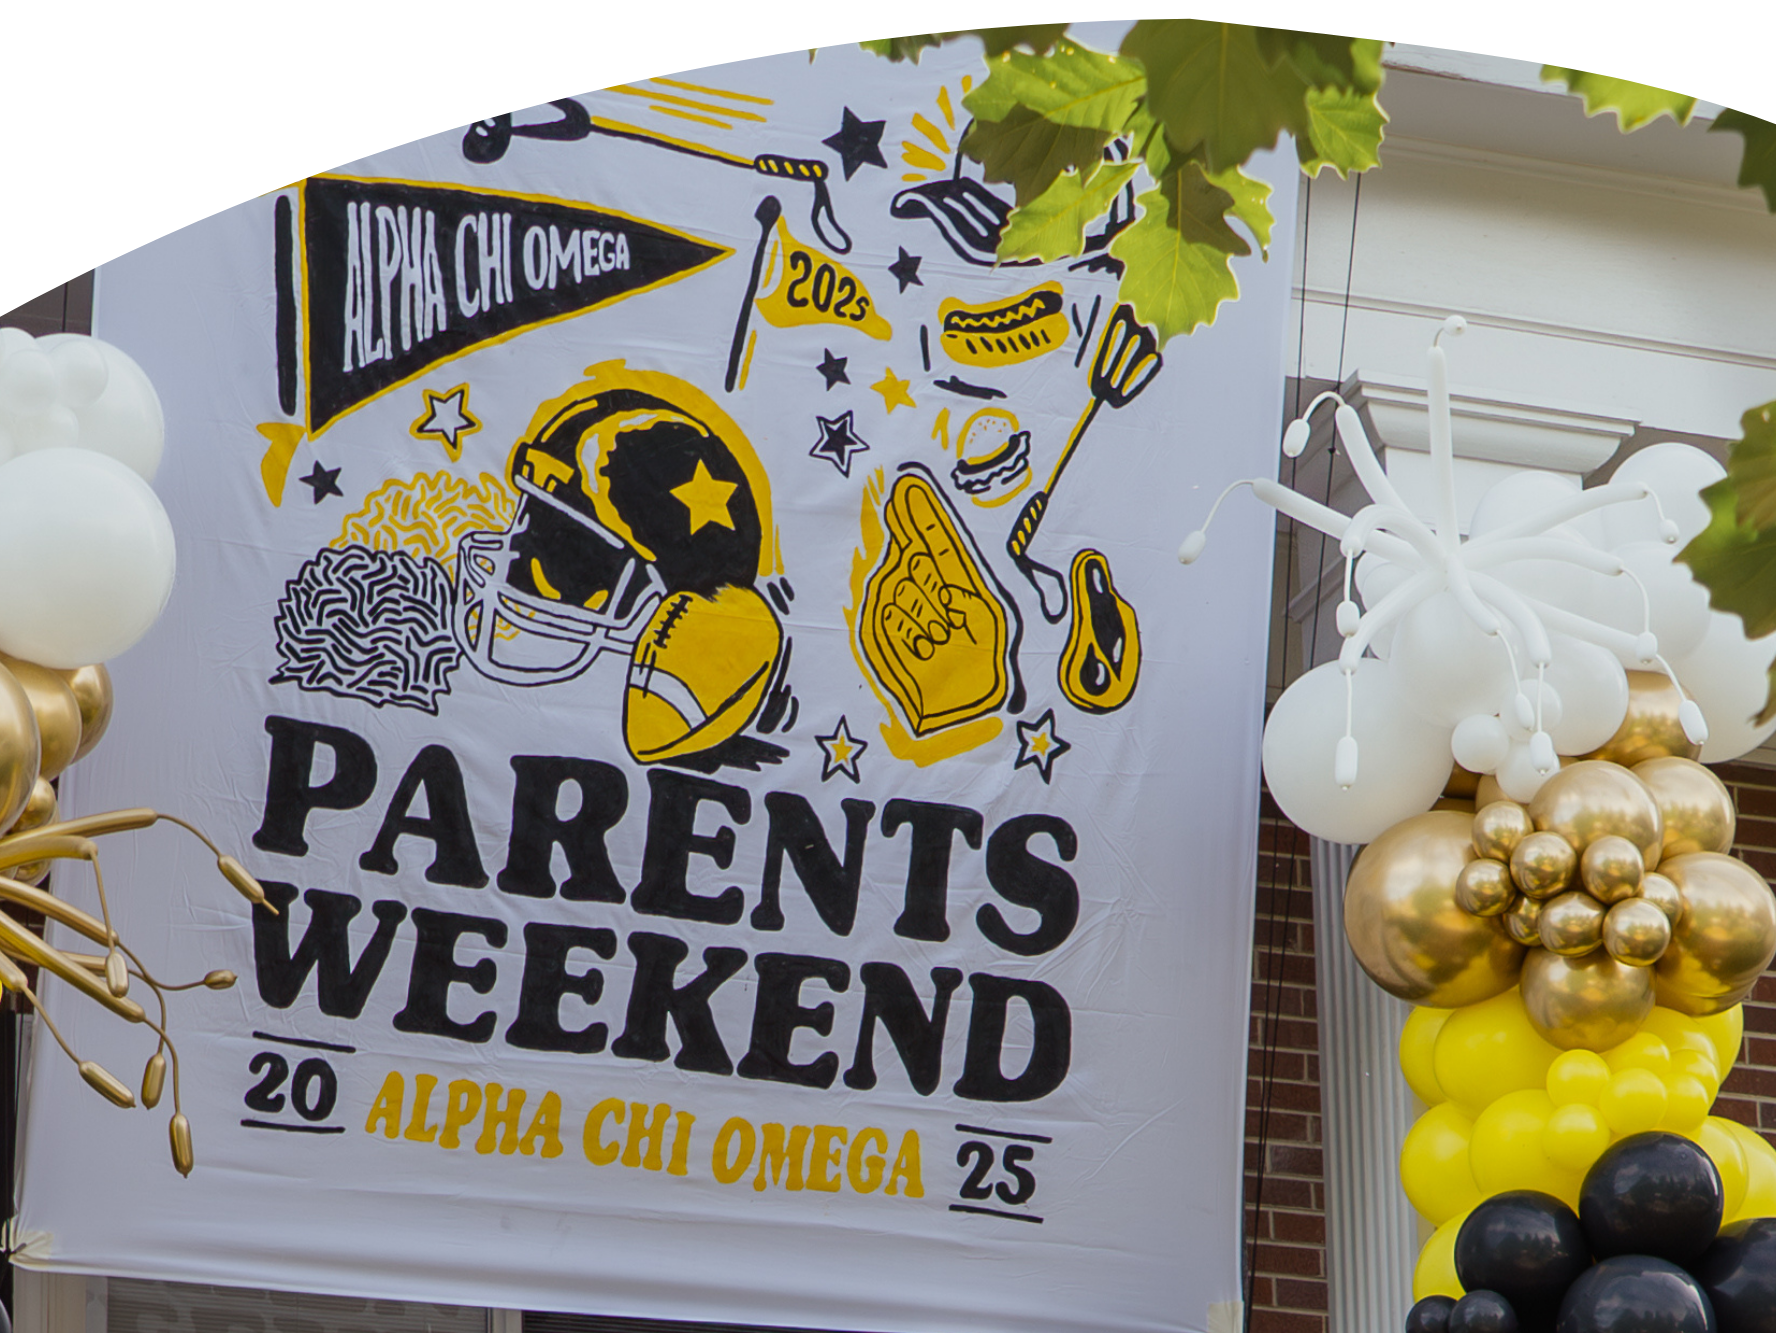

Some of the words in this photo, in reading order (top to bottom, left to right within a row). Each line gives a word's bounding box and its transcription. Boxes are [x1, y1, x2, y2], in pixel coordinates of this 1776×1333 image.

[343, 202, 447, 373] ALPHA
[454, 211, 514, 319] CHI
[523, 225, 631, 291] OMEGA
[786, 250, 871, 322] 2025
[251, 714, 1081, 958] PARENTS
[250, 881, 1073, 1104] WEEKEND
[244, 1051, 339, 1123] 20
[364, 1070, 565, 1160] ALPHA
[582, 1097, 697, 1178] CHI
[711, 1116, 926, 1200] OMEGA
[956, 1140, 1037, 1207] 25
